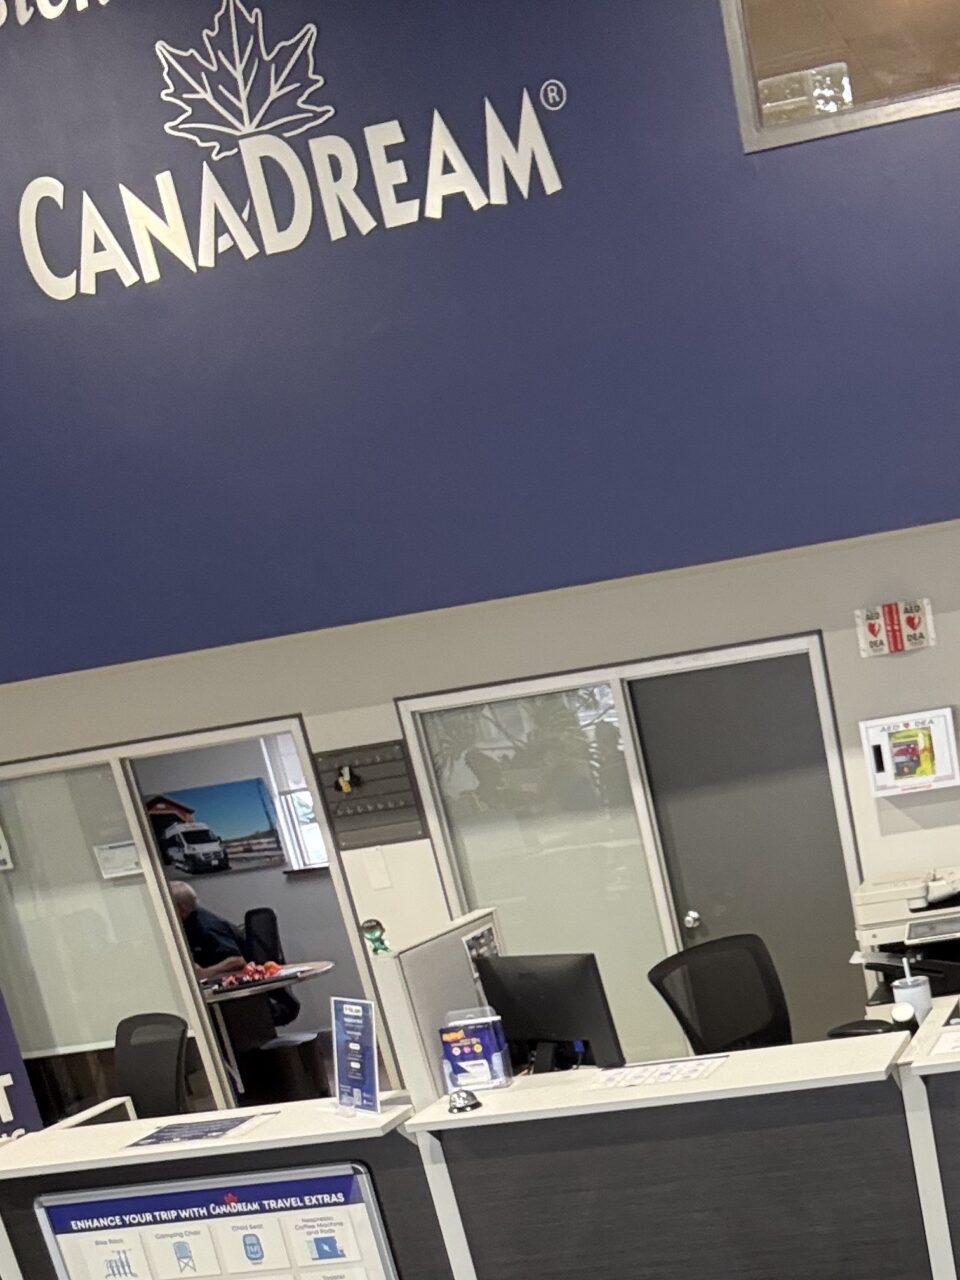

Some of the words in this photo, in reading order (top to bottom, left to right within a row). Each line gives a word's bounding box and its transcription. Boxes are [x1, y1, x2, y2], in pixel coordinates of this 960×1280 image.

[903, 605, 921, 614] AED
[906, 632, 925, 642] DEA
[869, 639, 885, 649] DEA
[70, 1215, 122, 1230] ENHANCE
[122, 1212, 153, 1225] YOUR
[154, 1210, 178, 1220] TRIP
[178, 1207, 208, 1219] WITH
[209, 1201, 260, 1215] CANADREAM
[262, 1197, 304, 1210] TRAVEL
[304, 1192, 345, 1206] EXTRAS
